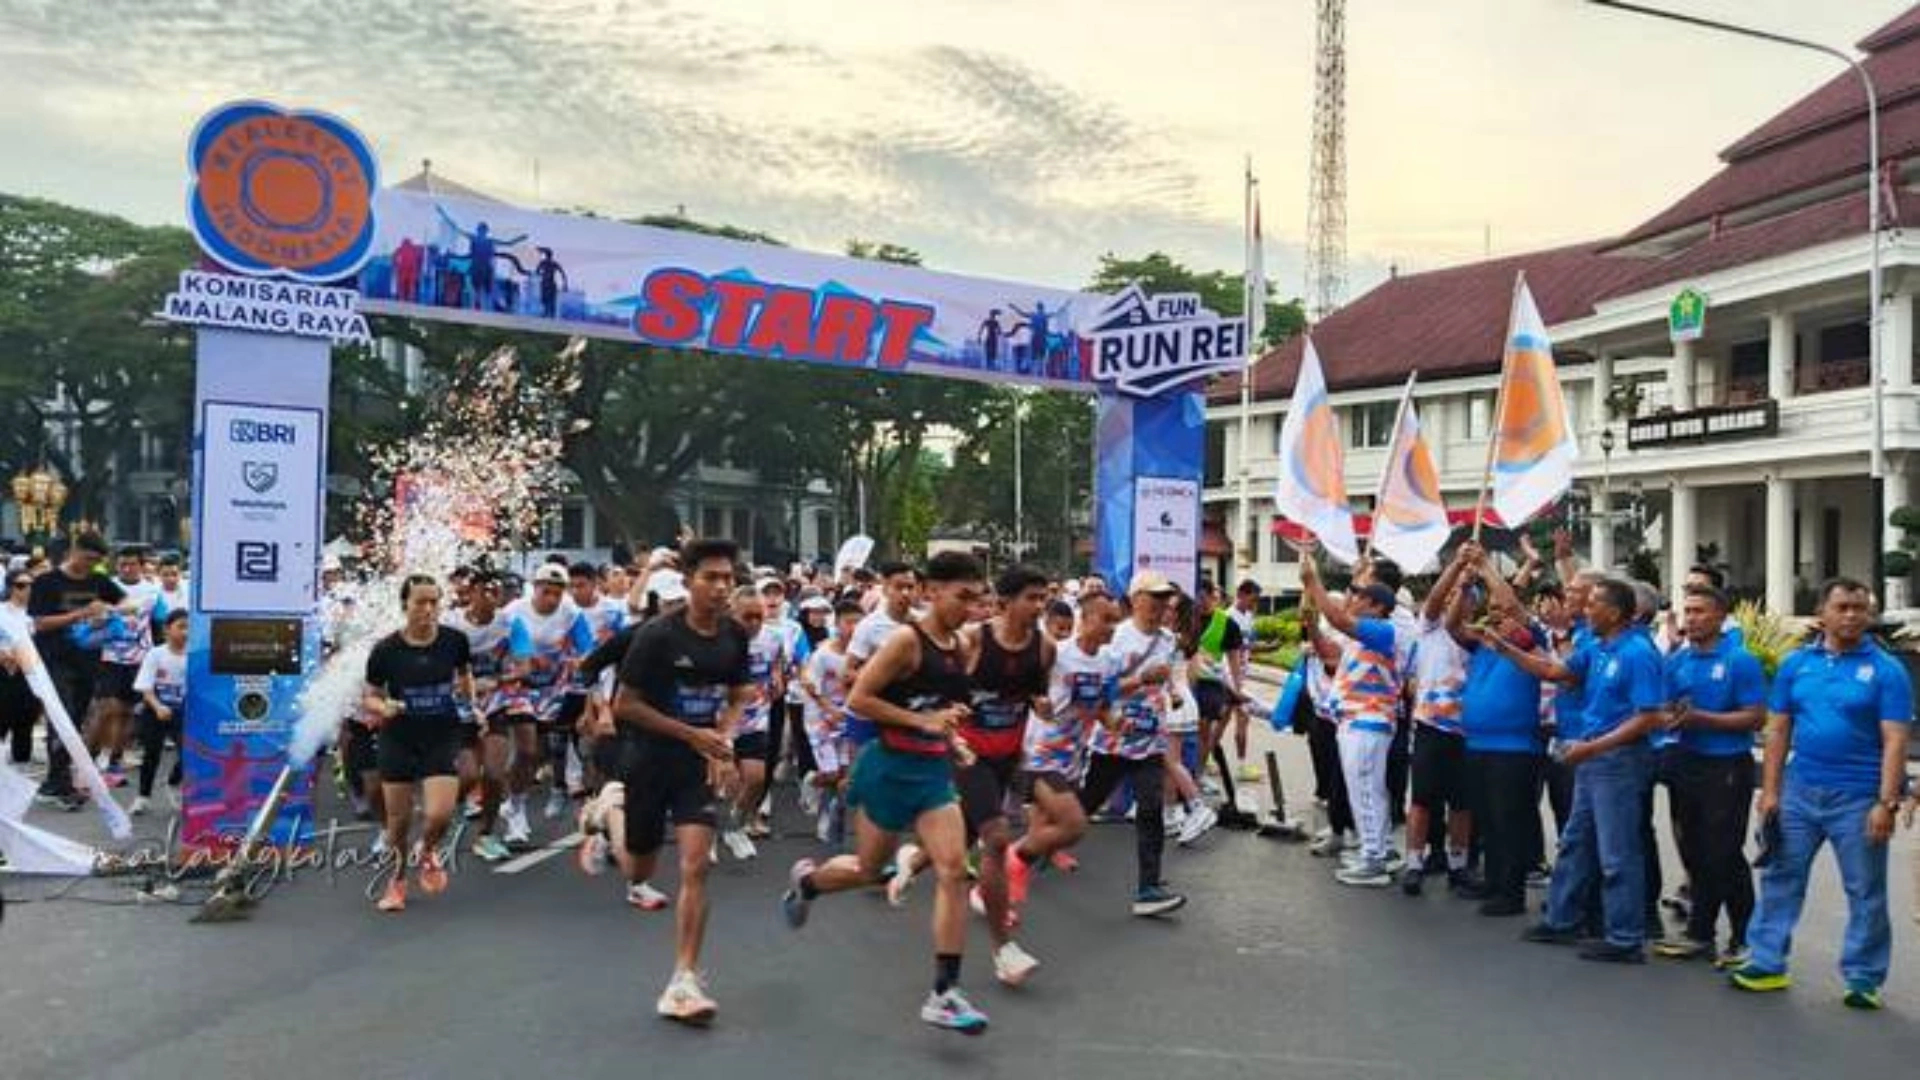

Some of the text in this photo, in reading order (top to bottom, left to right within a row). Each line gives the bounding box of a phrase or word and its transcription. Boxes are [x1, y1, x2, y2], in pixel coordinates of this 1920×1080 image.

[184, 275, 353, 310] KOMISARIAT
[1157, 298, 1197, 318] FUN
[170, 297, 367, 337] MALANG RAYA
[634, 266, 935, 371] START
[1100, 322, 1245, 373] RUN REI
[257, 422, 296, 445] BRI
